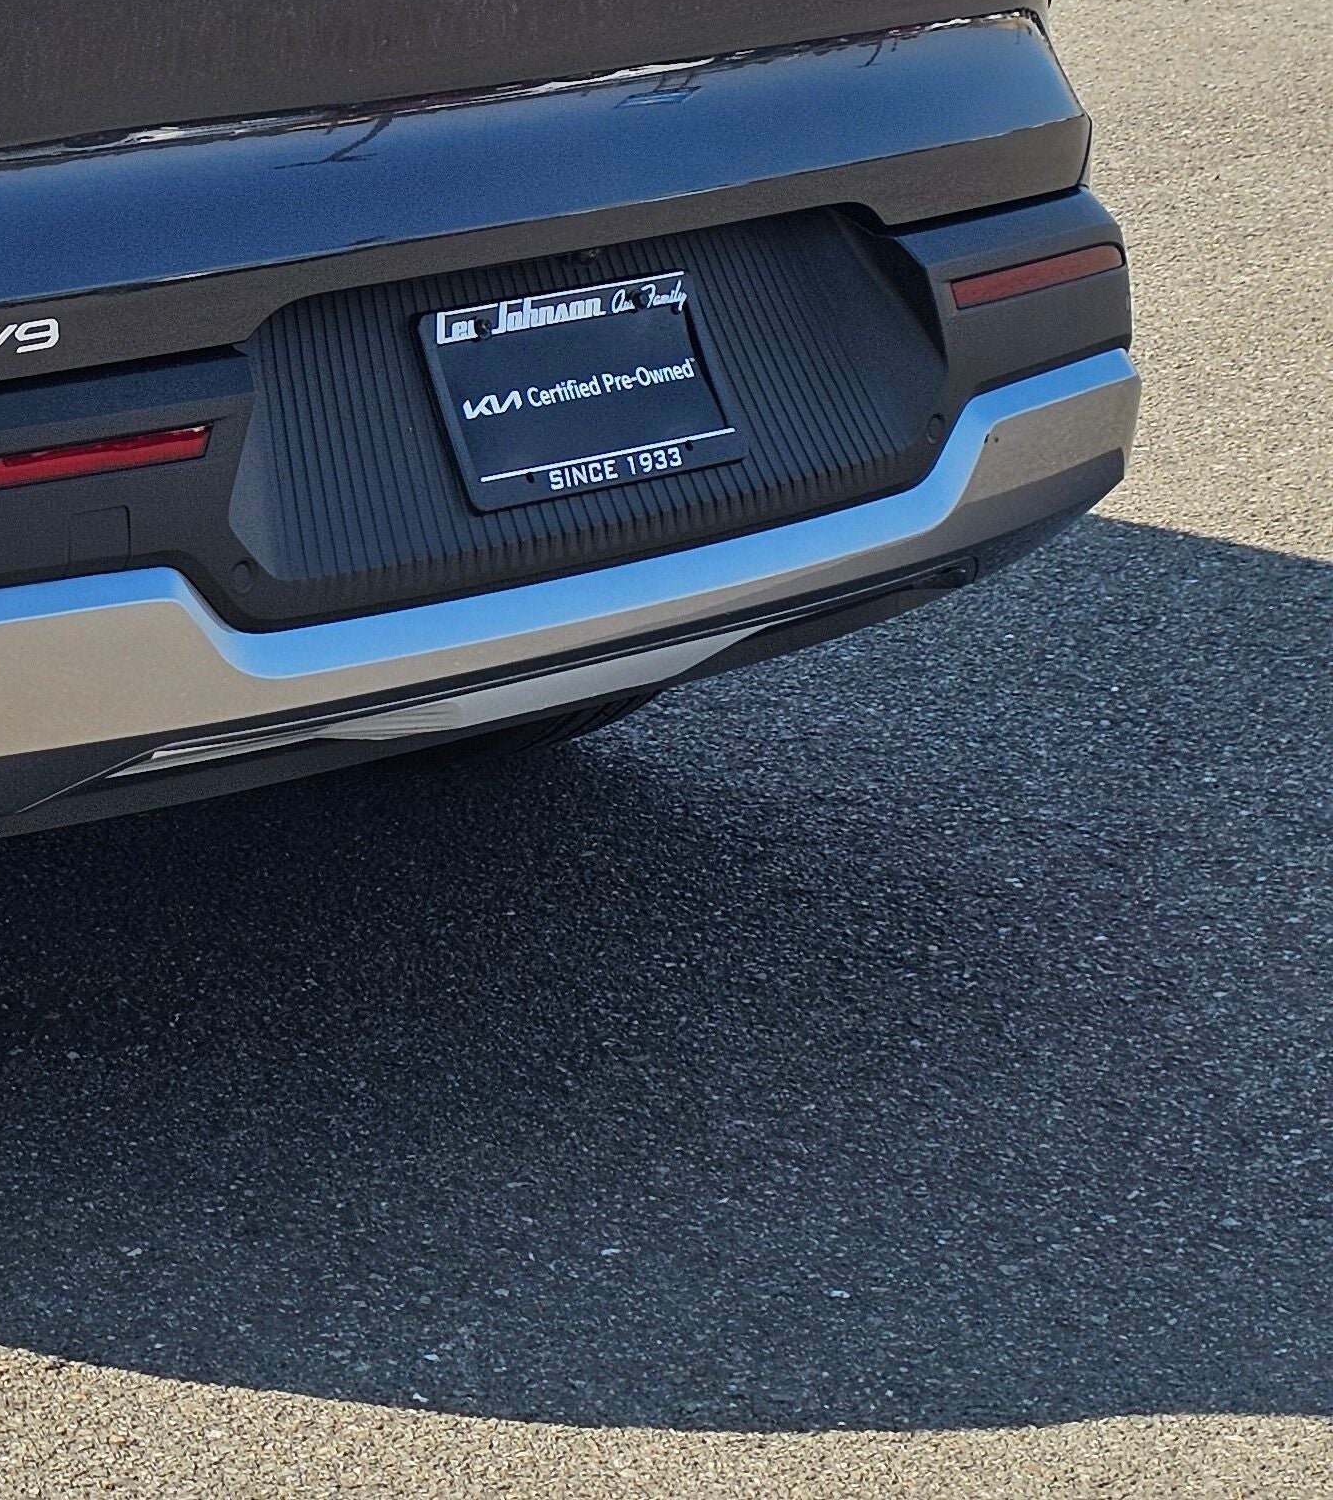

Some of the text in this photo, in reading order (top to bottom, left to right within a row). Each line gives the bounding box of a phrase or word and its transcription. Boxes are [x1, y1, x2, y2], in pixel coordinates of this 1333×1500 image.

[491, 296, 607, 335] Johnson
[462, 390, 523, 420] KIA
[526, 374, 602, 408] Certified
[548, 446, 683, 491] SINCE 1933
